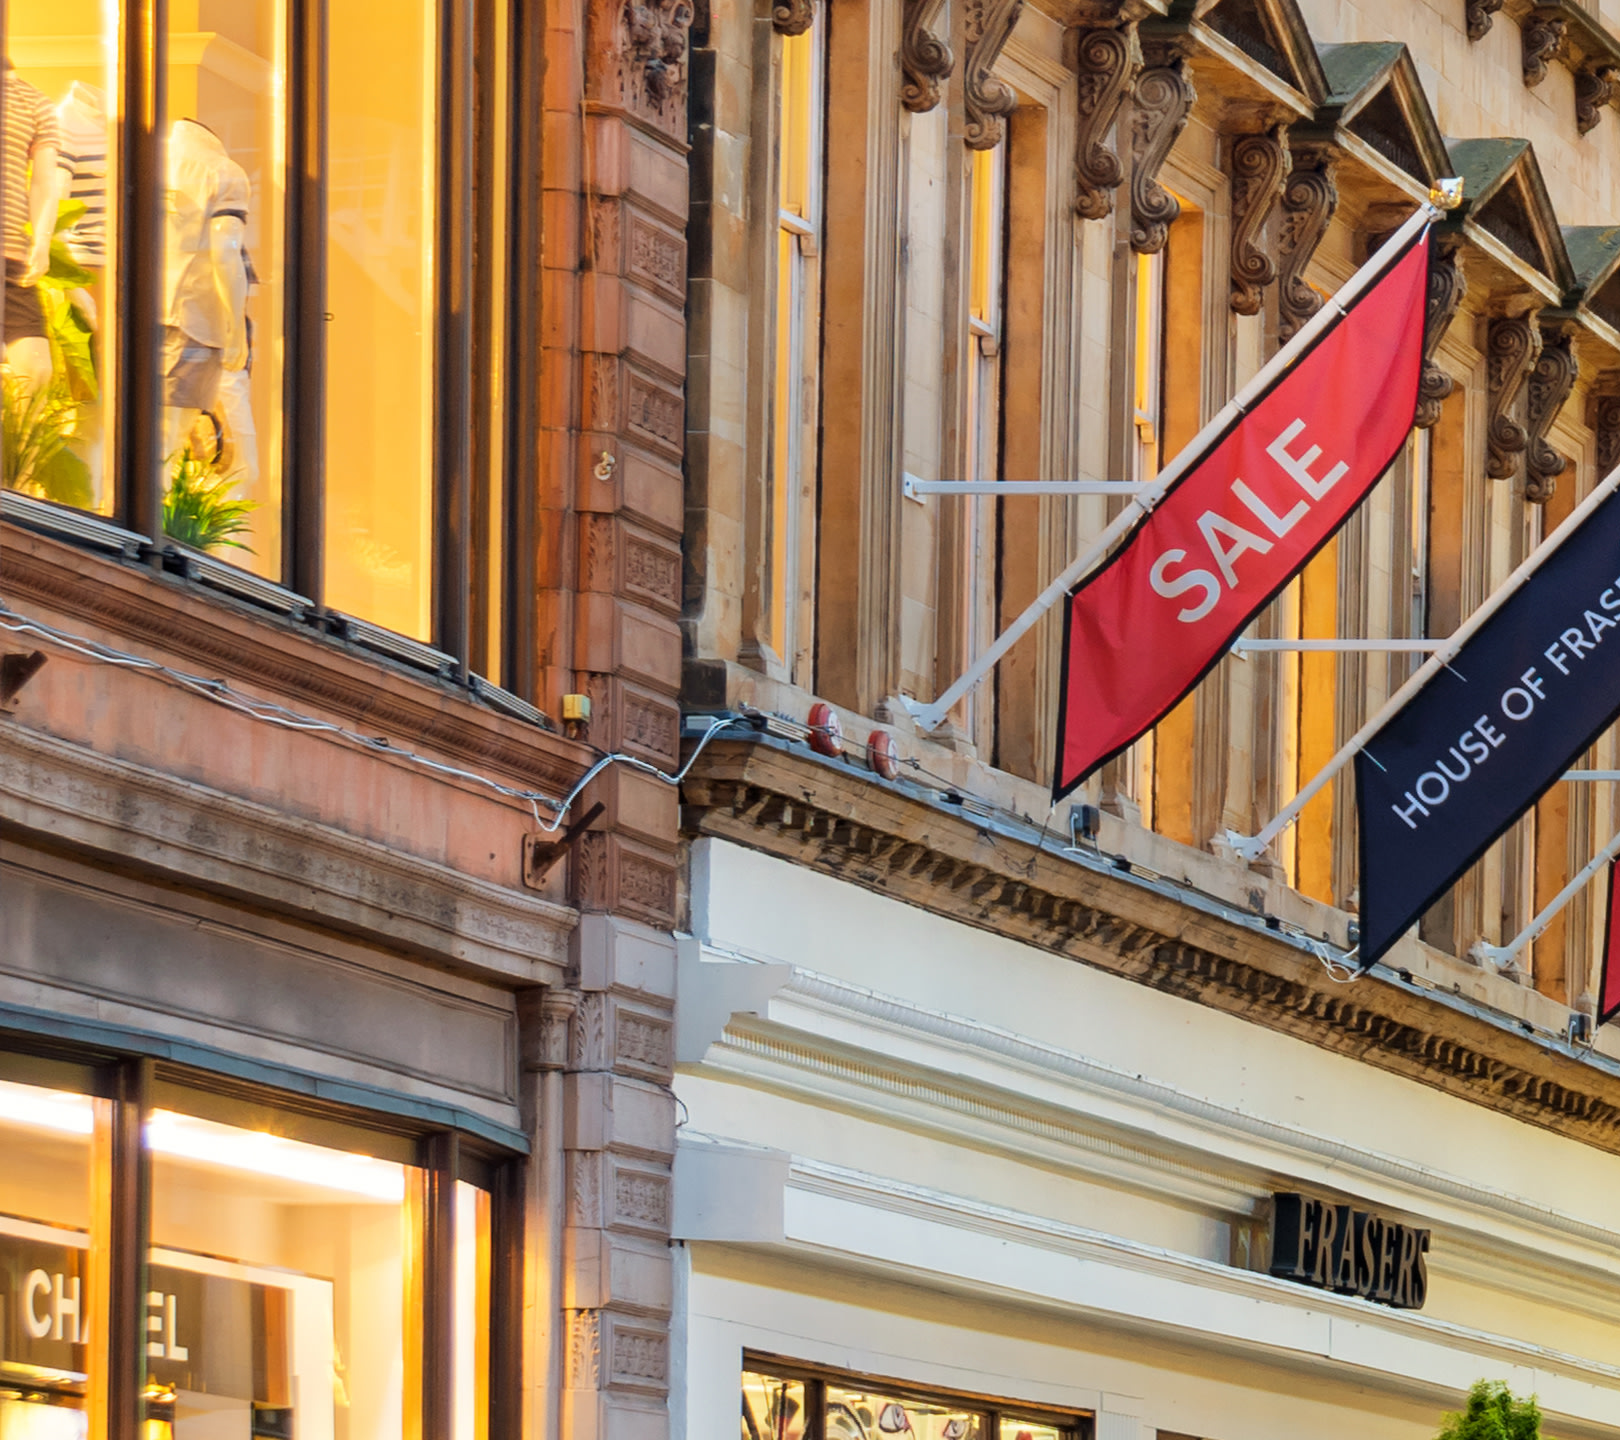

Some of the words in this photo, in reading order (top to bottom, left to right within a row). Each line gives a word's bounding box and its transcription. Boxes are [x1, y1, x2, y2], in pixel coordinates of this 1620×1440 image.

[1149, 417, 1350, 624] SALE
[1391, 714, 1506, 829] HOUSE
[1500, 667, 1546, 723] OF
[26, 1268, 189, 1362] CHEL
[1294, 1196, 1432, 1310] FRASERS
